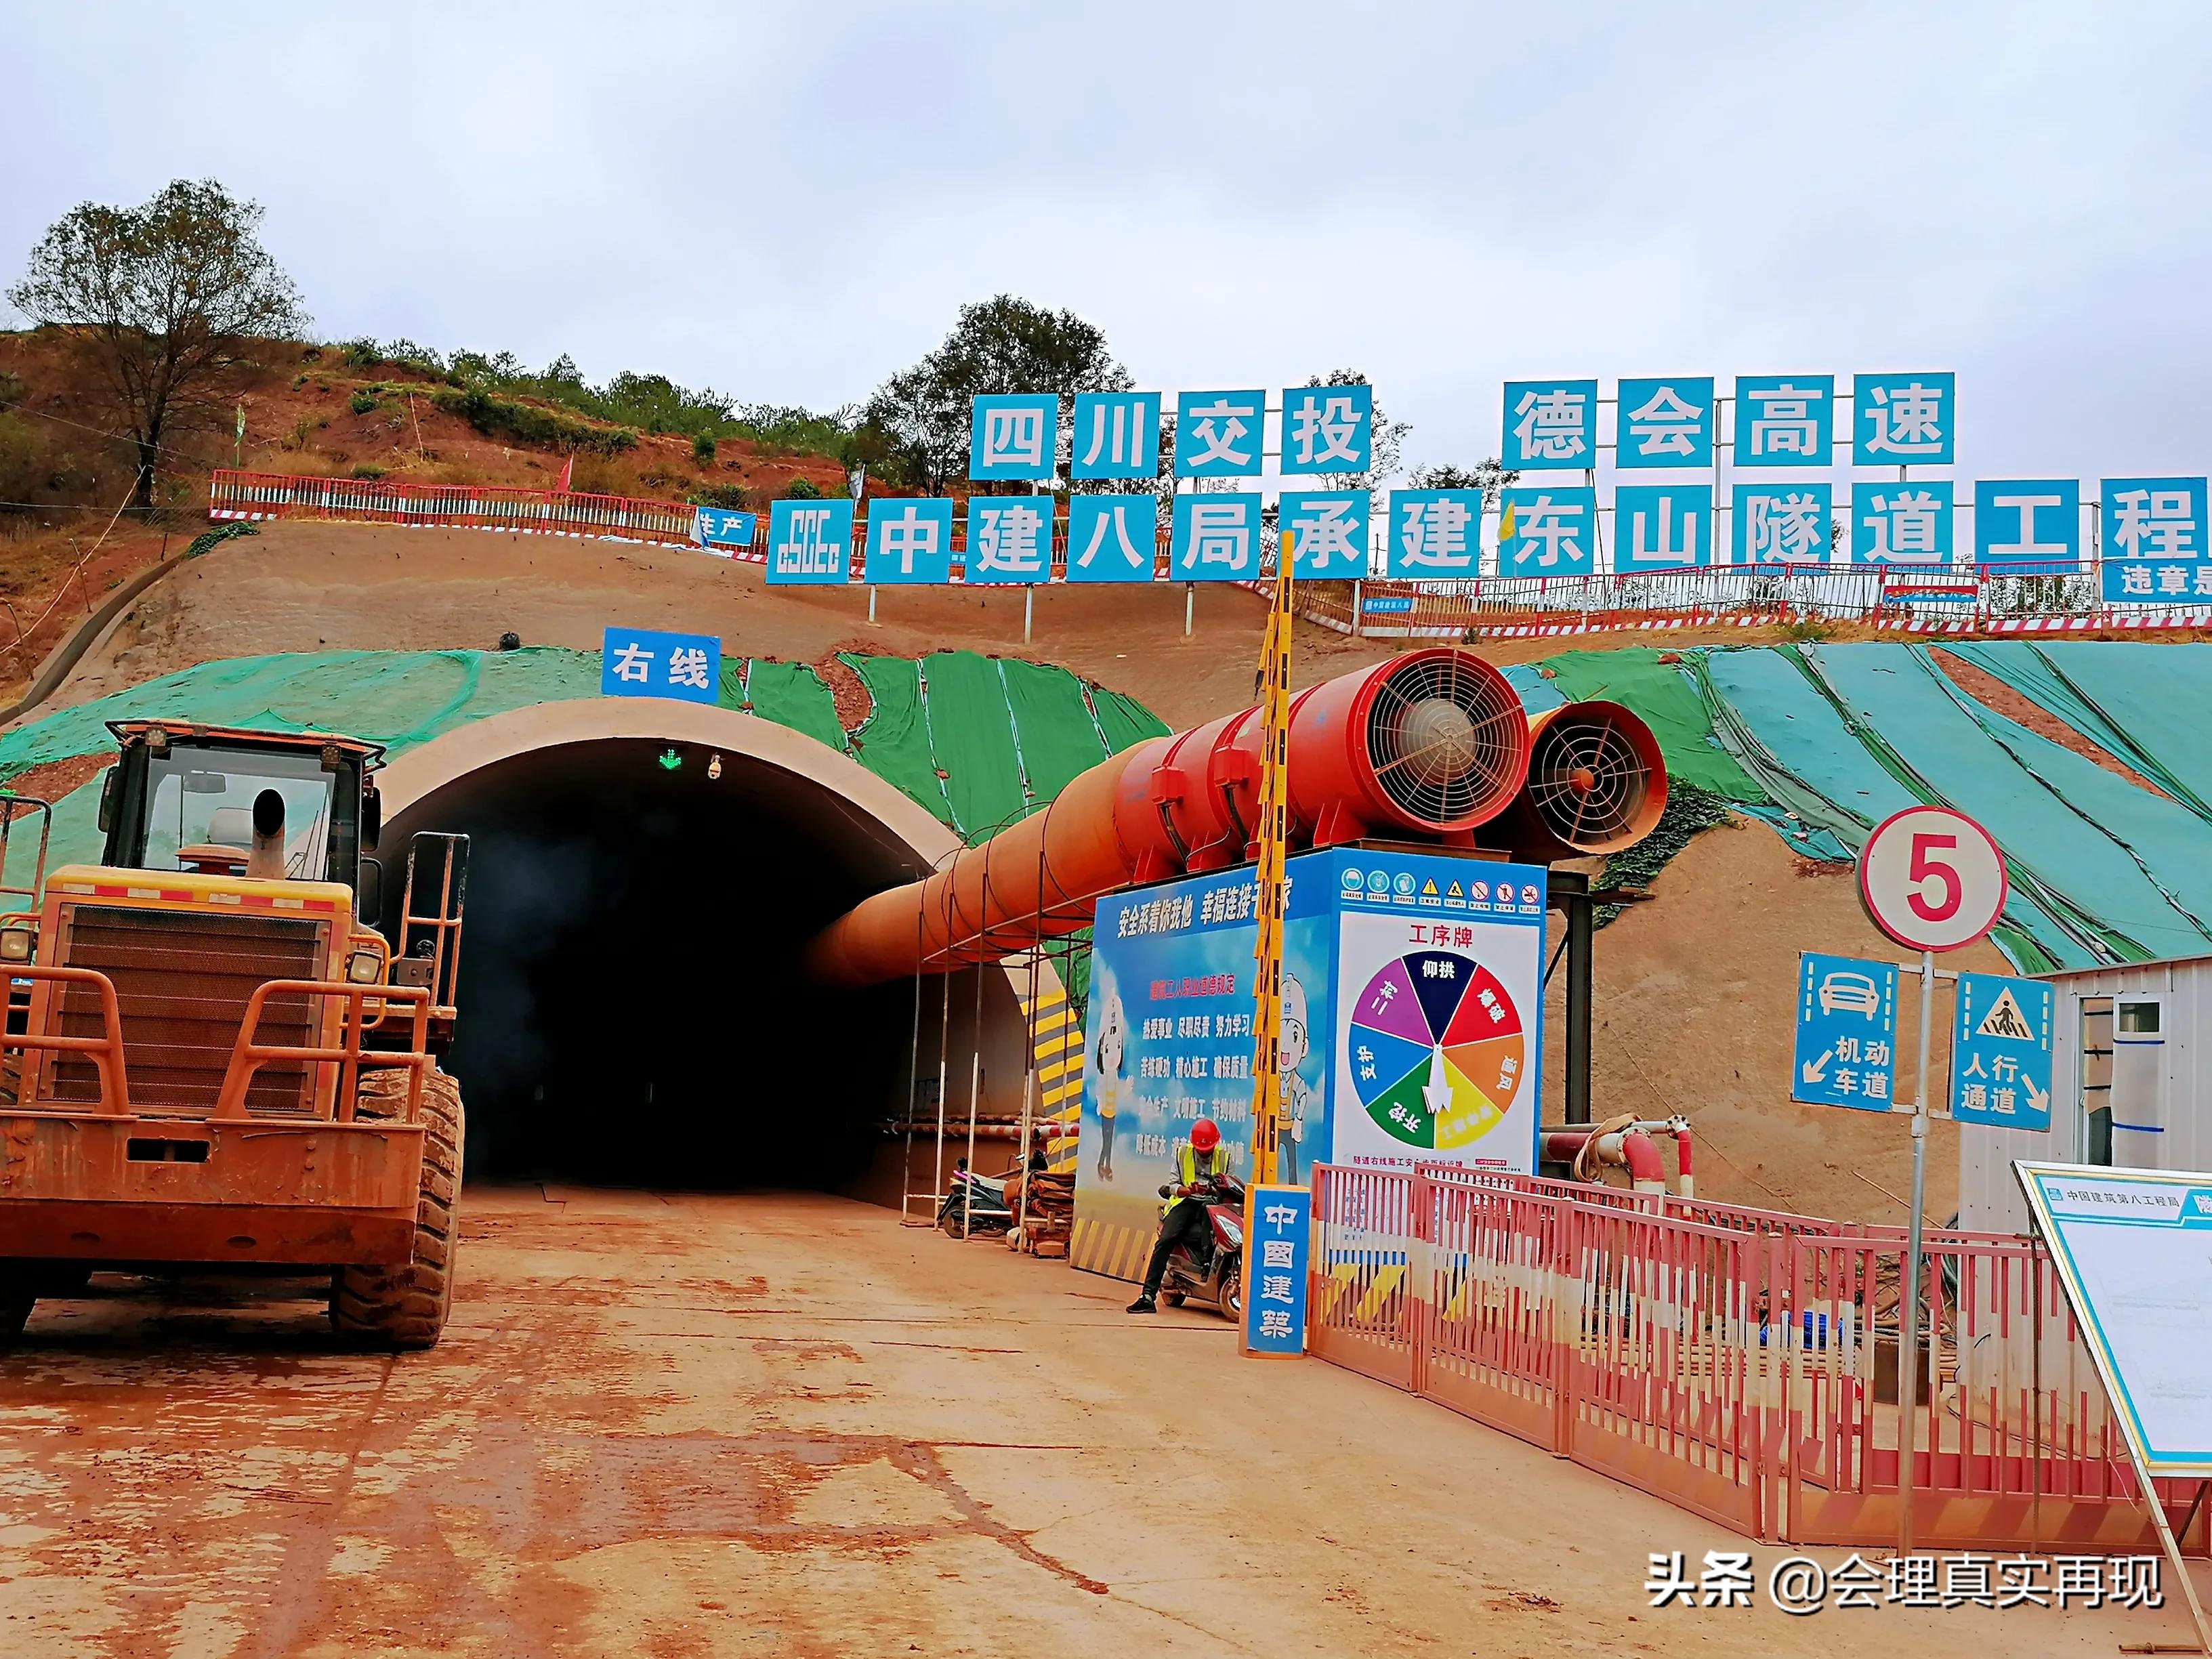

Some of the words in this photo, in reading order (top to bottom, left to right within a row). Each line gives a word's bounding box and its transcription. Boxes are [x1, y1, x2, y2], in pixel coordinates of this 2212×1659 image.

[982, 396, 1364, 467] 四川交投
[1513, 383, 1944, 460] 德会高速
[879, 488, 2198, 574] 中建八局承建东山隧道工程
[613, 642, 709, 689] 右线
[1906, 833, 1962, 922] 5
[1408, 924, 1473, 948] 工序牌
[1422, 960, 1455, 979] 仰拱
[1215, 1013, 1251, 1038] 努力学习
[1356, 1045, 1377, 1080] 支护
[1835, 1036, 1890, 1066] 机动
[1833, 1068, 1889, 1099] 车道
[1963, 1053, 2018, 1083] 人行
[1961, 1084, 2016, 1115] 通道
[1389, 1101, 1421, 1133] 开挖
[2066, 1190, 2180, 1207] 中国建筑第八工程局
